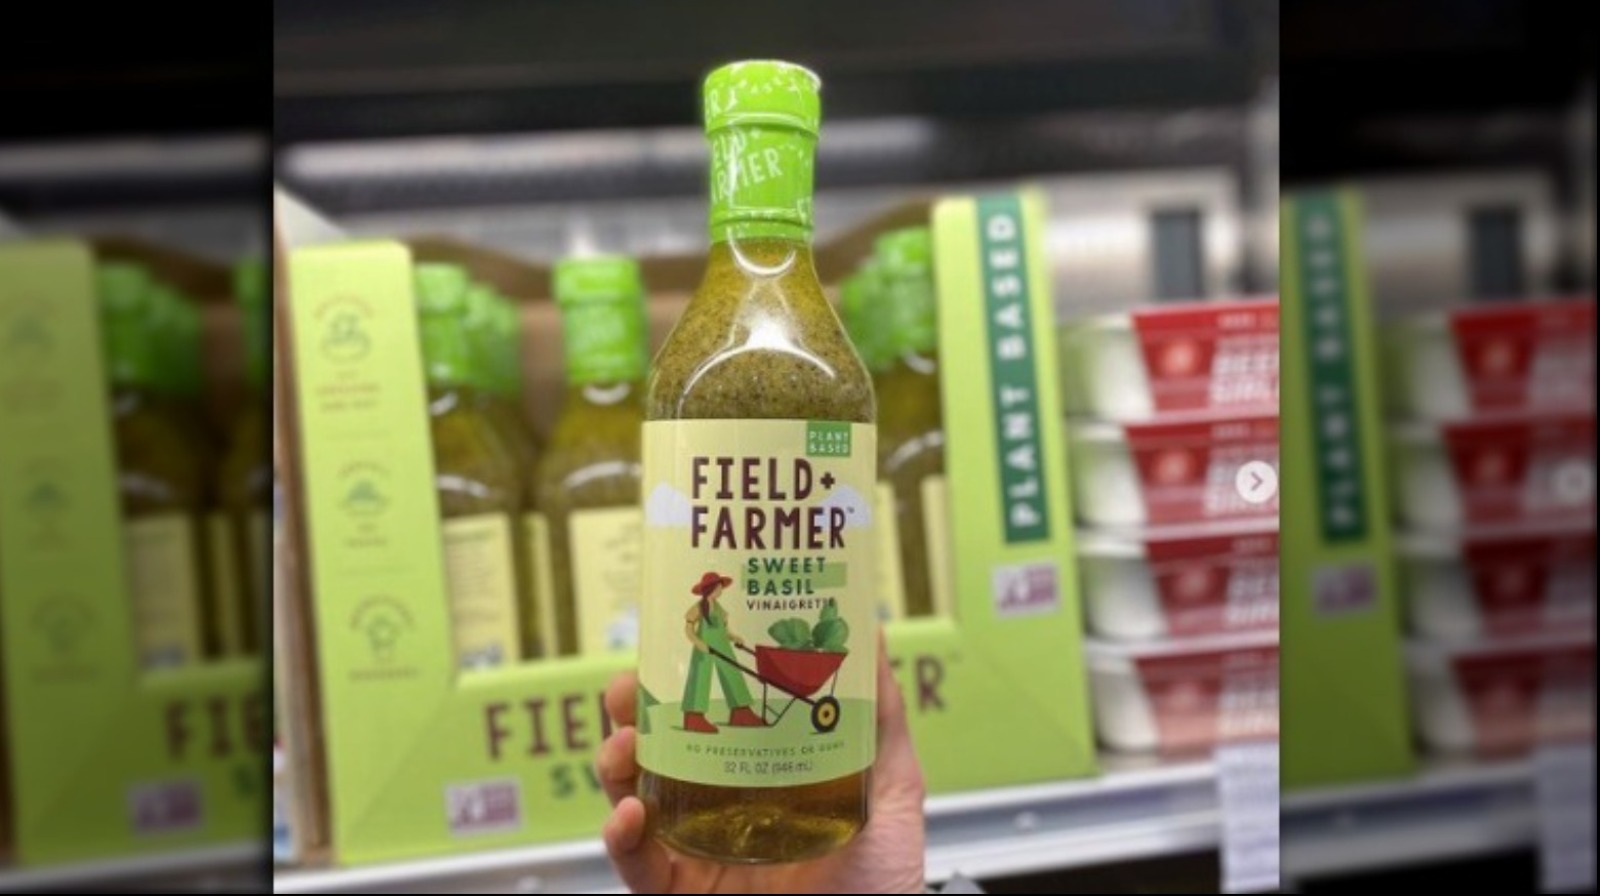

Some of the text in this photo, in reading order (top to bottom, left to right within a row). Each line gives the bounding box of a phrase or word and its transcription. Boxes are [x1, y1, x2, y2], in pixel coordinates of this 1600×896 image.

[986, 212, 1027, 361] BASED
[809, 431, 849, 441] PLANT
[1000, 384, 1041, 528] PLANT
[748, 557, 825, 574] SWEET
[747, 578, 814, 596] BASIL
[706, 747, 796, 758] PRESERVATIVES
[724, 761, 737, 774] 32
[754, 761, 769, 774] OZ
